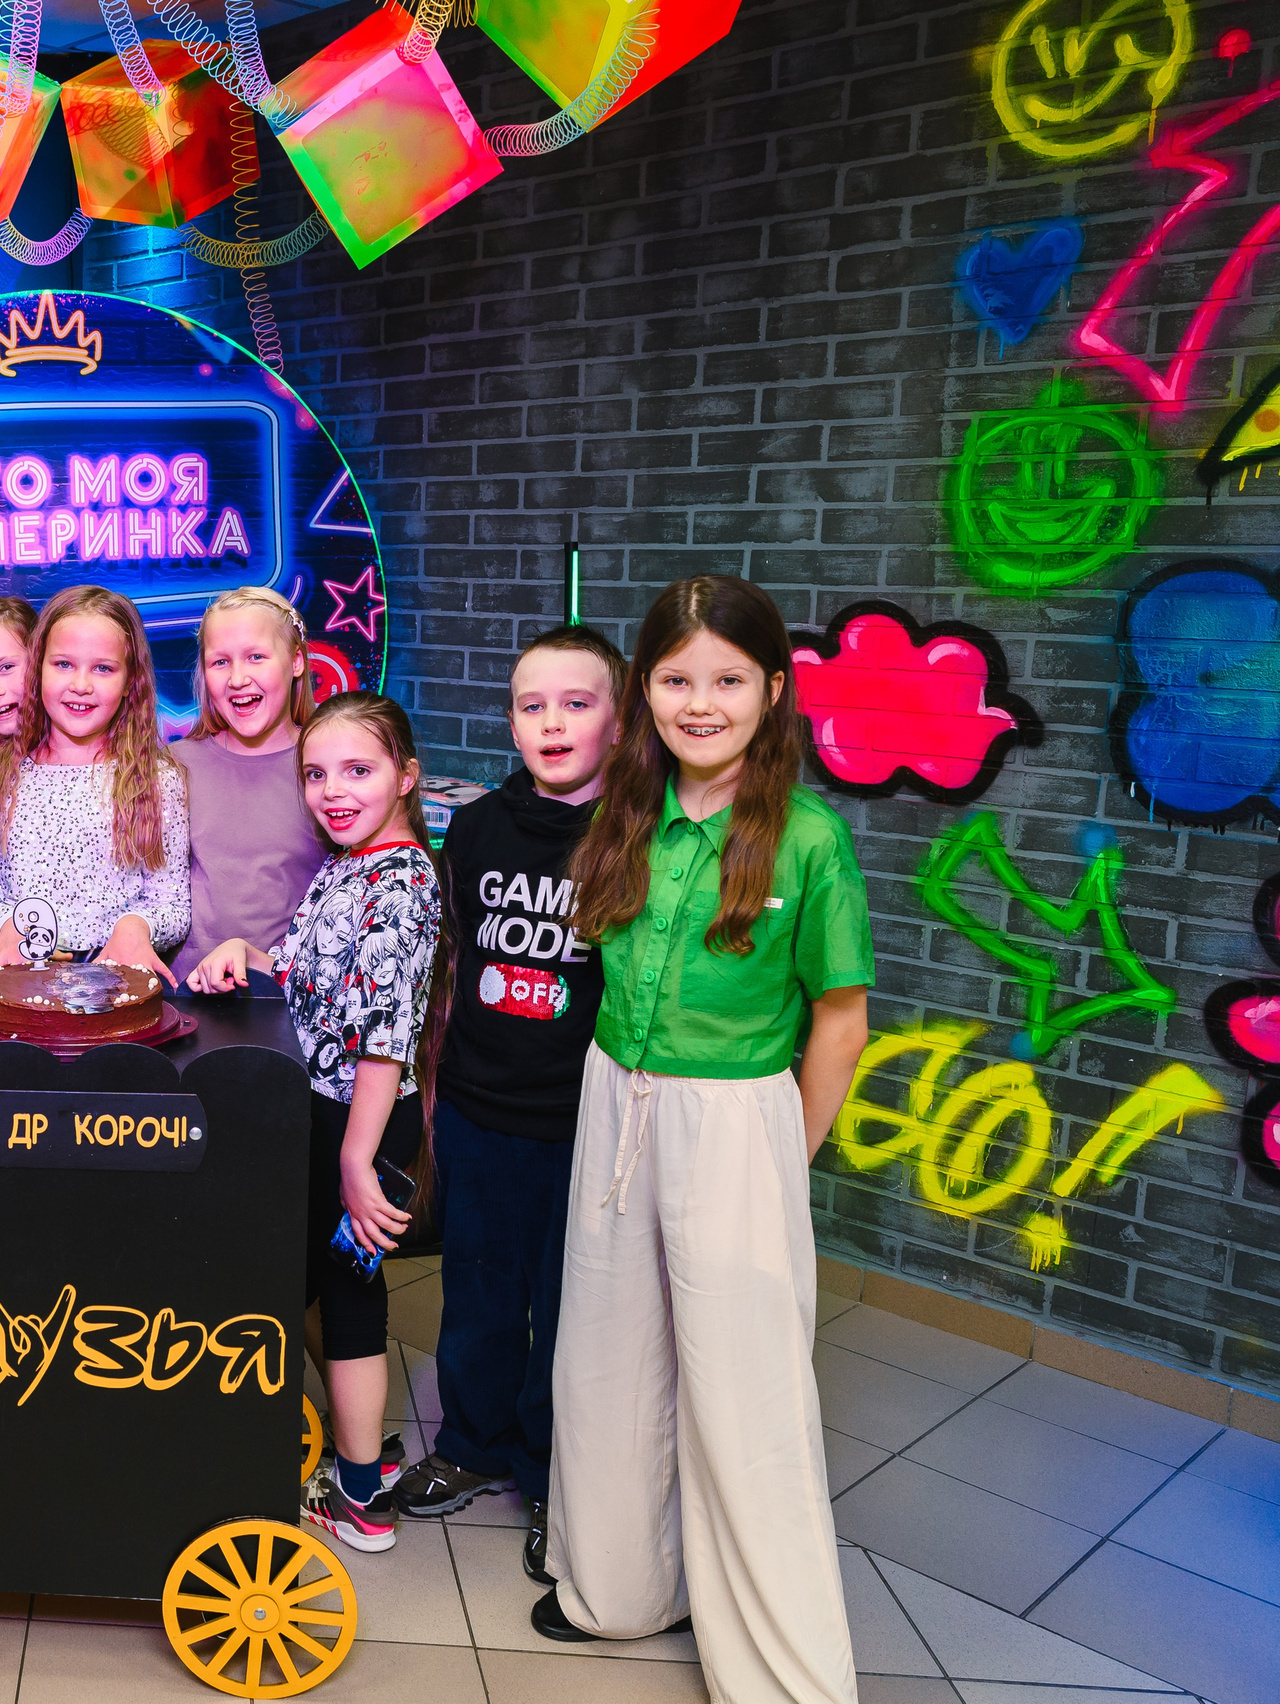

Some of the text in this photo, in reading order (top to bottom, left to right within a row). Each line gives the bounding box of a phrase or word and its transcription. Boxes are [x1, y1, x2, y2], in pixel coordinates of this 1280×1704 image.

[70, 453, 208, 507] МОЯ
[479, 870, 583, 918] GAM
[476, 912, 592, 963] MODE
[7, 1112, 49, 1150] ДР
